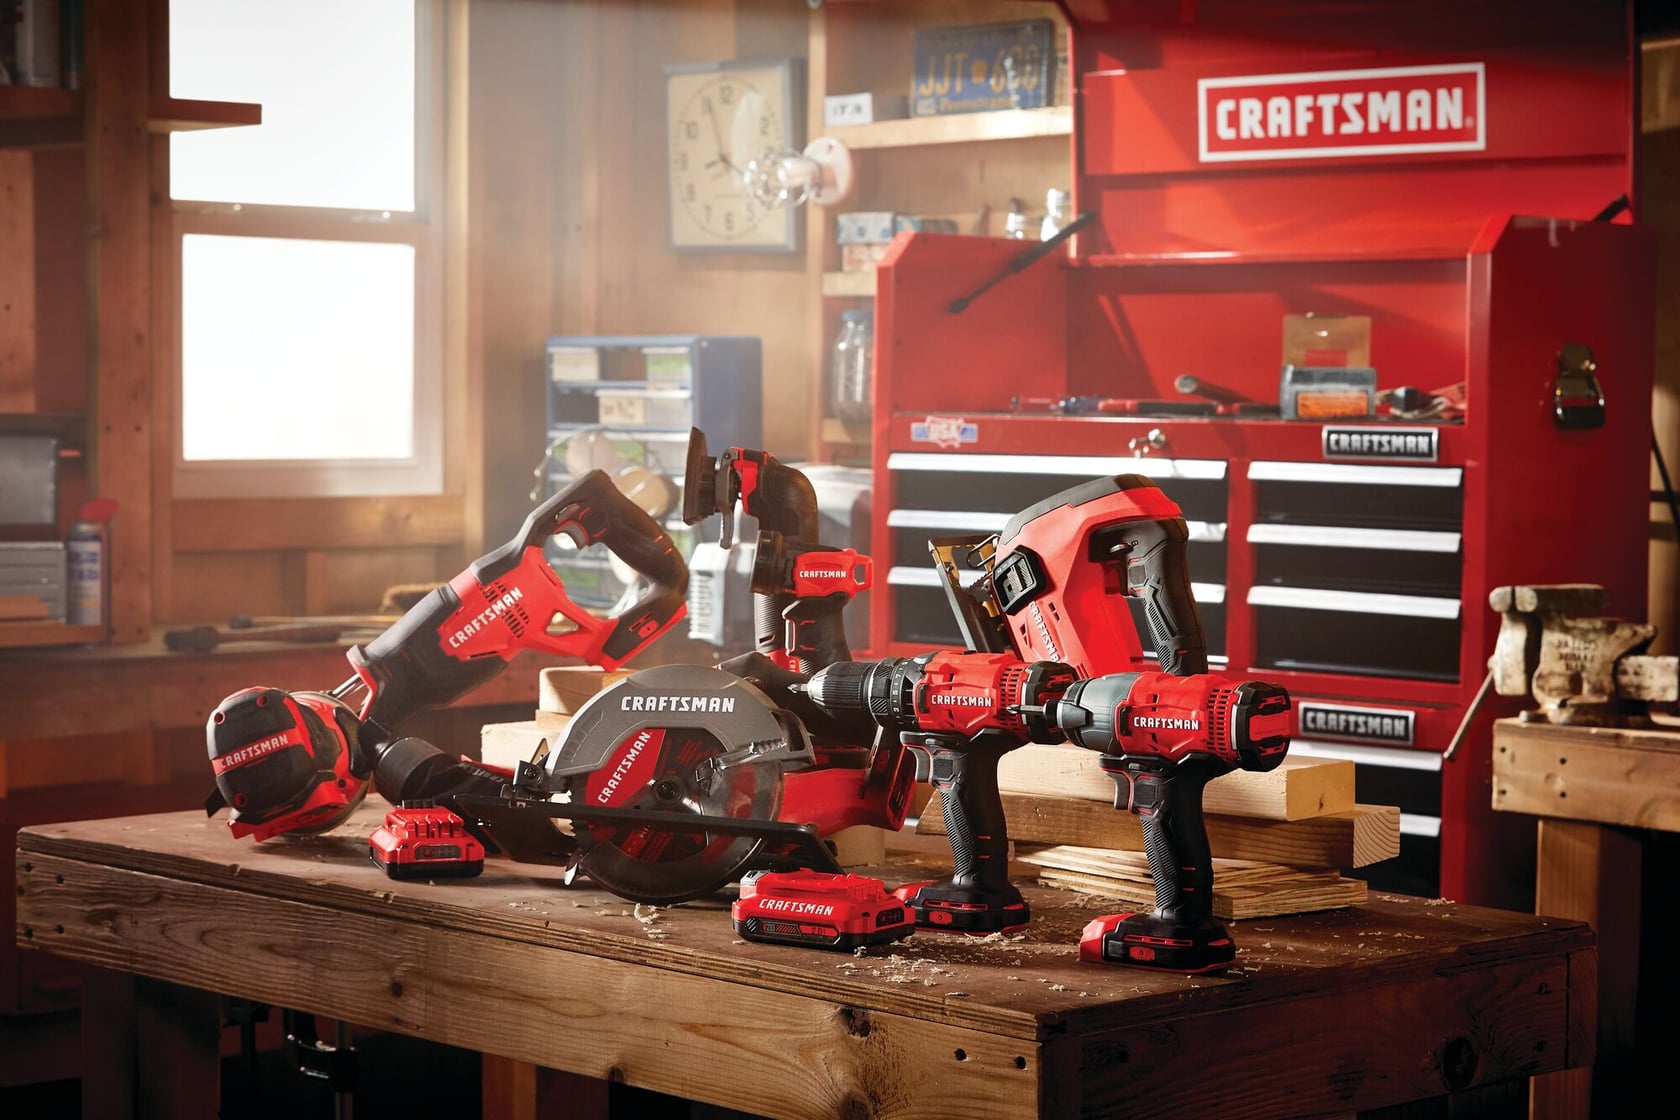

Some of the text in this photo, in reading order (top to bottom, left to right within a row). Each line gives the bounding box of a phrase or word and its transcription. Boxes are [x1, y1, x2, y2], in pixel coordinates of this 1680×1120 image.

[1216, 87, 1463, 140] CRAFTSMAN
[1329, 433, 1429, 454] CRAFTSMAN
[799, 570, 846, 578] CRAFTSMAN
[448, 587, 523, 648] CRAFTSMAN
[1028, 600, 1060, 663] CRAFTSMA
[621, 696, 735, 713] CRAFTSMAN
[931, 694, 992, 707] CRAFTSMAN
[1133, 716, 1199, 730] CRAFTSMAN
[1306, 711, 1405, 736] CRAFTSMAN
[220, 734, 288, 768] CRAFTSMAN
[597, 731, 651, 803] CRAFTSMAN
[759, 899, 834, 916] CRAFTSMAN
